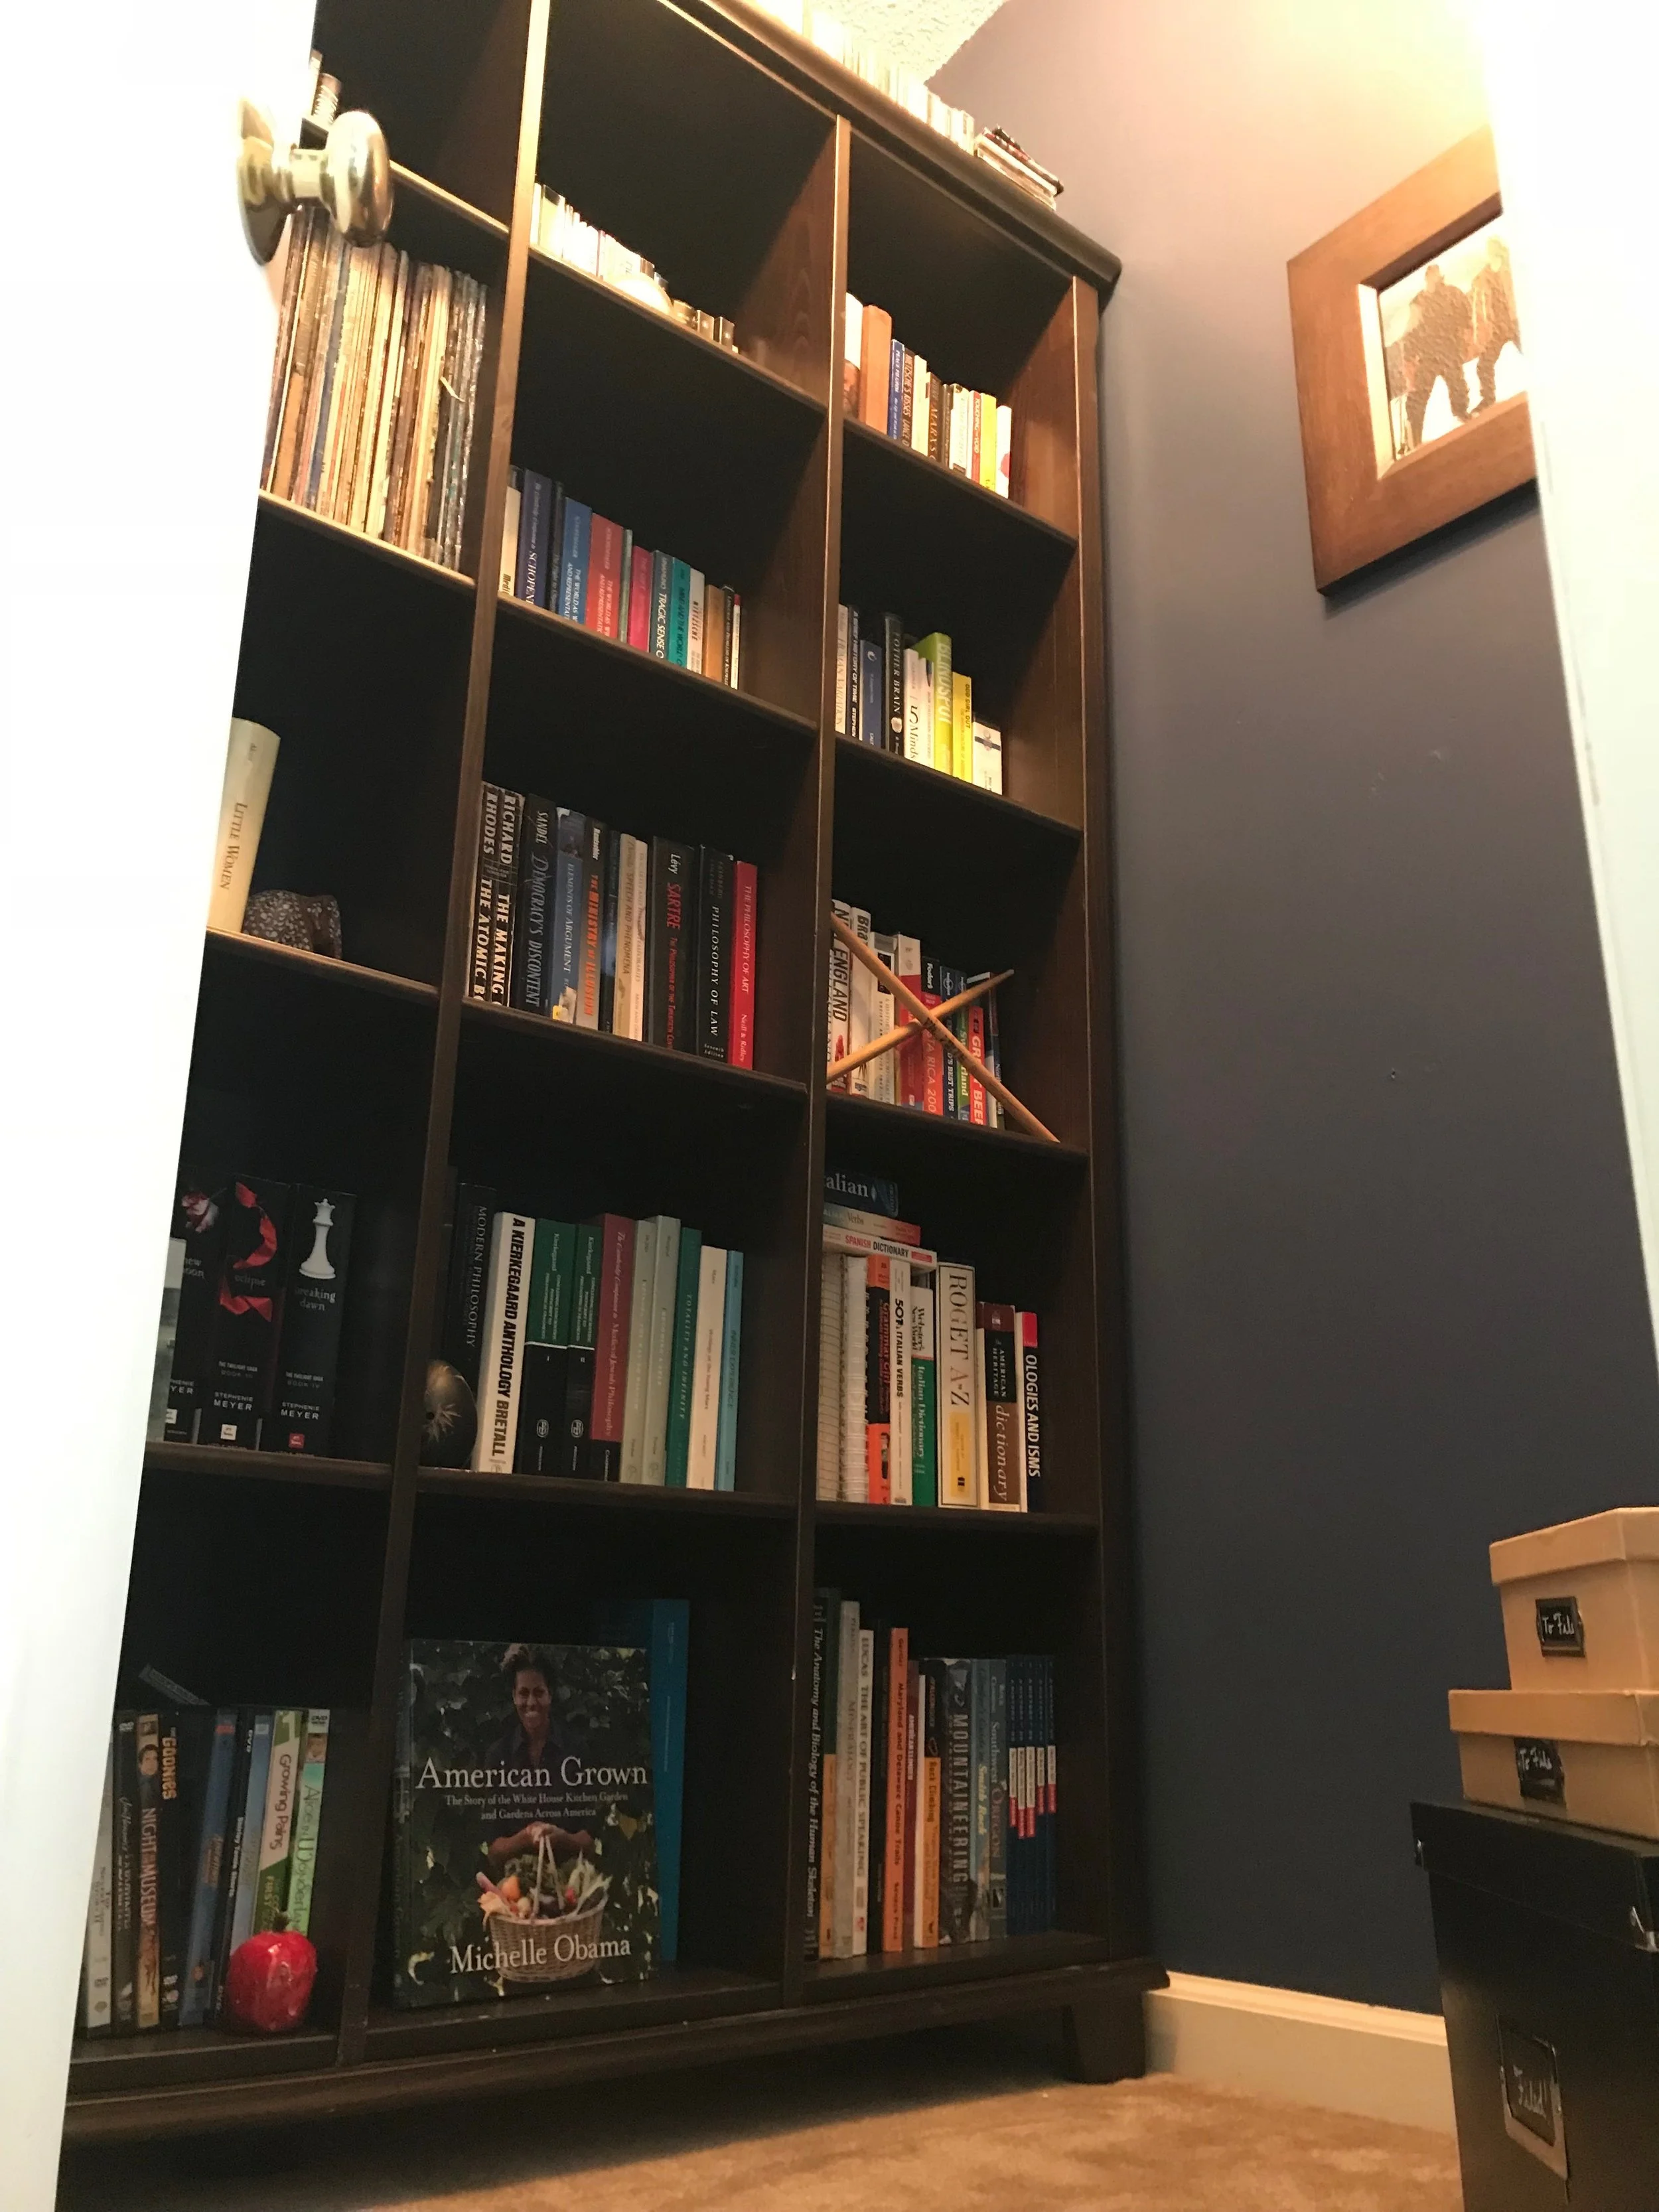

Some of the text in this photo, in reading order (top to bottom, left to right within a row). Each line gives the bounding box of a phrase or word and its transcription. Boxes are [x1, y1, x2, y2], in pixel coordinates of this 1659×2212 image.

[656, 593, 667, 650] TRAGIC SENSE
[852, 672, 857, 683] OF
[938, 642, 952, 723] BLINDSPOT
[910, 725, 918, 759] Minds
[220, 802, 248, 890] LITTLE WOMEN
[483, 792, 498, 855] RHODES
[500, 795, 516, 864] RICHARD
[536, 811, 548, 844] SANDEL
[666, 853, 682, 930] Lévy SARTRE
[474, 879, 492, 978] THE ATOMIC
[563, 863, 575, 973] ELEMENTS OF ARGUMENT
[742, 904, 751, 962] PHILOSOPHY
[492, 894, 510, 994] THE MAKING
[584, 873, 599, 1016] THE MINISTRY ILLUSION
[622, 924, 632, 975] PHENOMENA
[711, 905, 719, 986] PHILOSOPHY
[526, 940, 543, 1007] DISCONTENT
[741, 976, 750, 994] ART
[742, 963, 750, 975] OF
[832, 948, 848, 1021] ENGLAND
[711, 990, 719, 1005] OF
[926, 1057, 937, 1084] RICA
[826, 1173, 869, 1197] alian
[845, 1235, 909, 1257] SPANISH DICTIONARY
[465, 1206, 488, 1348] MODERN PHILOSOPHY
[299, 1299, 325, 1311] dawn
[684, 1294, 692, 1343] TOTALITY
[895, 1298, 904, 1327] 501
[949, 1273, 968, 1361] ROGET
[492, 1218, 526, 1456] A KIERKEGAARD ANTHOLOGY BRETALL
[214, 1392, 253, 1402] STEPHENIE
[214, 1399, 253, 1411] MEYER
[281, 1402, 320, 1411] STEPHENIE
[281, 1409, 319, 1420] MEYER
[605, 1386, 615, 1436] Philosophy
[679, 1371, 687, 1420] INFINITY
[1026, 1355, 1041, 1477] OLOGIES AND ISMS
[1542, 1617, 1553, 1635] To
[860, 1637, 869, 1678] LUCAS
[859, 1714, 868, 1737] ART
[895, 1682, 904, 1730] Maryland
[415, 1755, 648, 1789] American Grown
[806, 1627, 824, 1917] The Anatomy and Biology of the Human Skeleton
[859, 1740, 868, 1757] OF
[928, 1761, 937, 1782] Rock
[990, 1721, 1001, 1783] Southwest
[270, 1754, 293, 1850] Growing Pains
[304, 1785, 320, 1824] Alice
[446, 1792, 628, 1806] The Story of the White House Kitchen Garden
[858, 1761, 867, 1806] PUBLIC
[926, 1785, 937, 1824] Climbing
[952, 1714, 968, 1883] MOUNTAINEERING
[977, 1763, 988, 1836] Smith Rock
[481, 1808, 596, 1820] and Gardens Across America
[140, 1808, 157, 1925] NIGHT MUSEUM
[856, 1810, 866, 1878] SPEAKING
[449, 1934, 631, 1974] Michelle Obama
